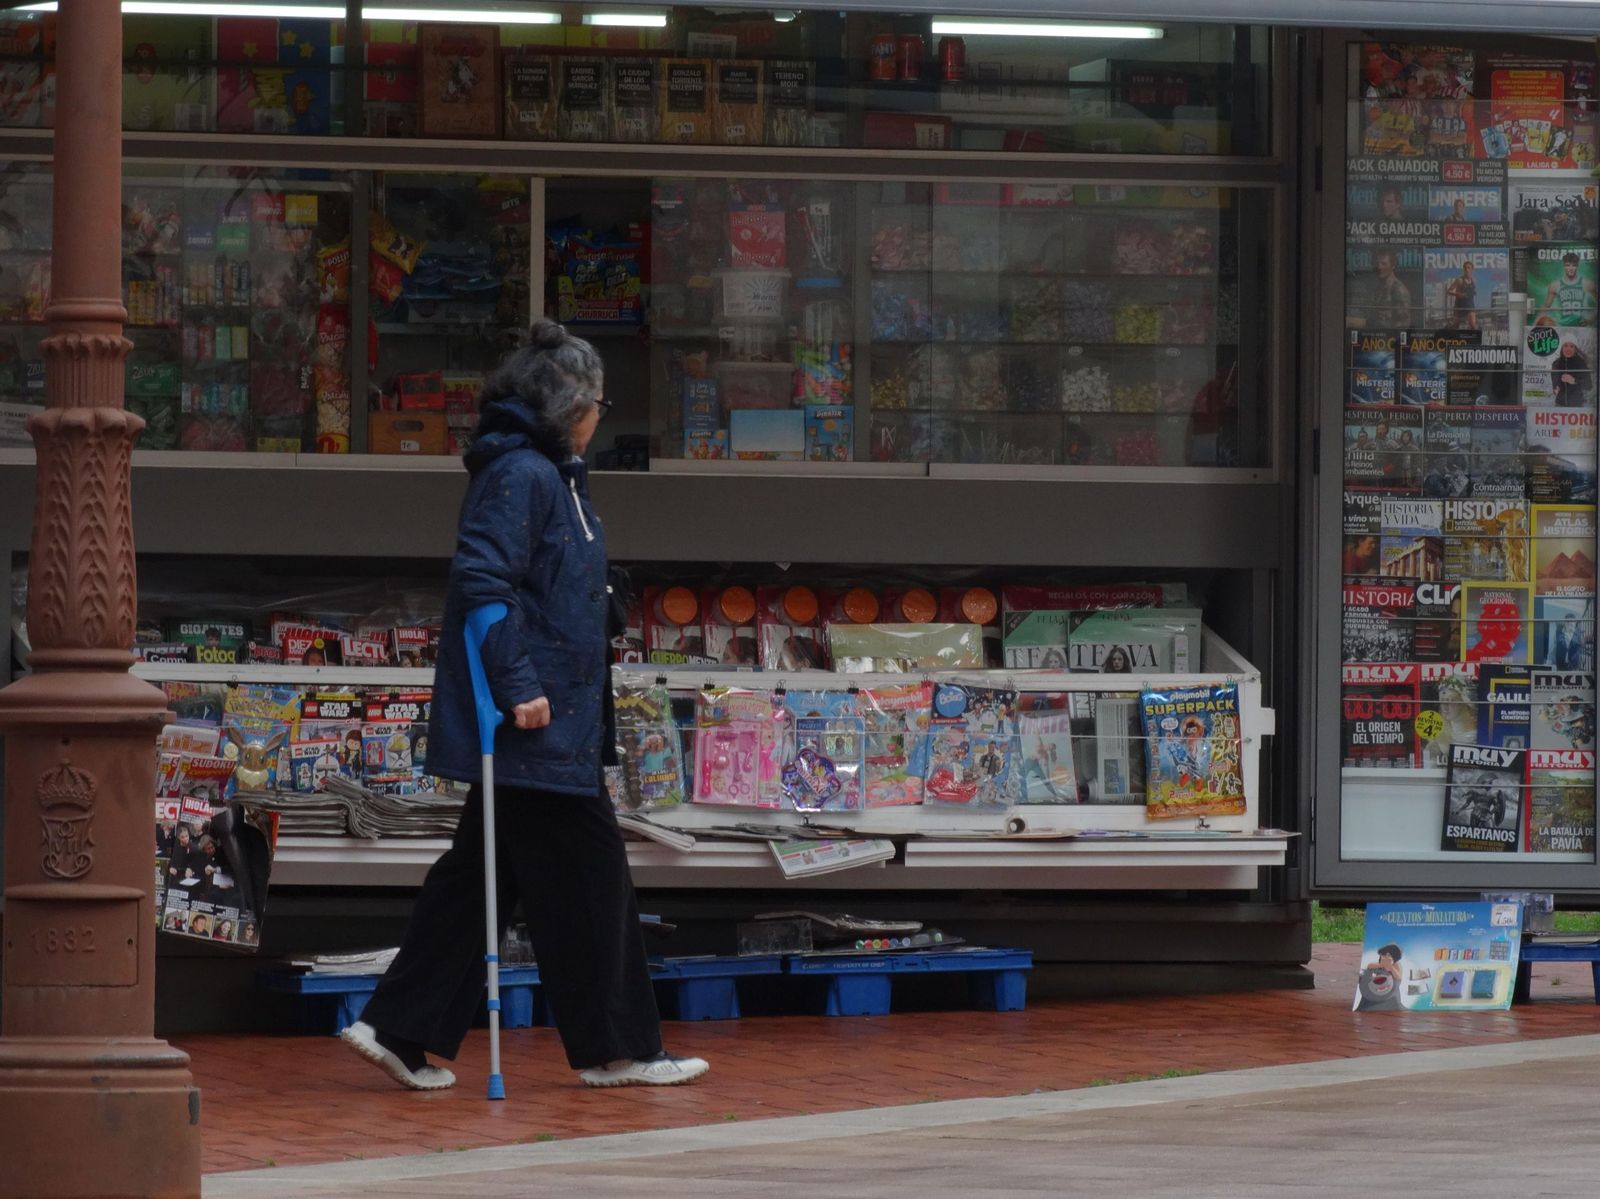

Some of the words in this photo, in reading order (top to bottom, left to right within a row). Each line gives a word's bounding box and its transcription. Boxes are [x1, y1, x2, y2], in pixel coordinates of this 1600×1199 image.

[775, 72, 804, 80] TERENCI
[1346, 160, 1374, 172] ACK
[1378, 160, 1440, 173] GANADOR
[1429, 190, 1500, 208] UNNER'S
[1380, 222, 1440, 236] GANADOR
[577, 310, 618, 320] CHURRUCA
[1528, 329, 1553, 342] Sport
[1534, 337, 1558, 354] Life
[1525, 377, 1545, 385] 2026
[1345, 410, 1384, 420] ESPERTA
[1390, 412, 1419, 420] FERRO
[1474, 412, 1520, 422] DESPERTA
[1535, 412, 1596, 426] HISTORI
[1384, 503, 1434, 514] HISTORIA
[1391, 515, 1420, 526] VIDA
[1554, 518, 1588, 527] ATLAS
[1089, 592, 1110, 600] CON
[1072, 644, 1159, 668] TEVA
[1342, 666, 1414, 682] muy
[1534, 675, 1596, 690] muy
[1170, 690, 1210, 701] playmobil
[322, 702, 349, 710] STAR
[388, 703, 420, 712] STAR
[1145, 700, 1235, 716] SUPERPACK
[320, 708, 350, 718] WARS
[384, 710, 419, 720] WARS
[1356, 722, 1368, 732] EL
[1368, 722, 1400, 732] ORIGEN
[1353, 733, 1370, 744] DEL
[1372, 733, 1404, 744] TIEMPO
[1454, 746, 1520, 768] muy
[1530, 751, 1595, 768] muy
[192, 758, 235, 769] SUDOKU
[1446, 825, 1516, 843] ESPARTANOS
[1539, 827, 1550, 836] LA
[1550, 827, 1583, 836] BATALLA
[1551, 836, 1583, 850] PAVÍA
[1424, 912, 1468, 922] MINIATURA
